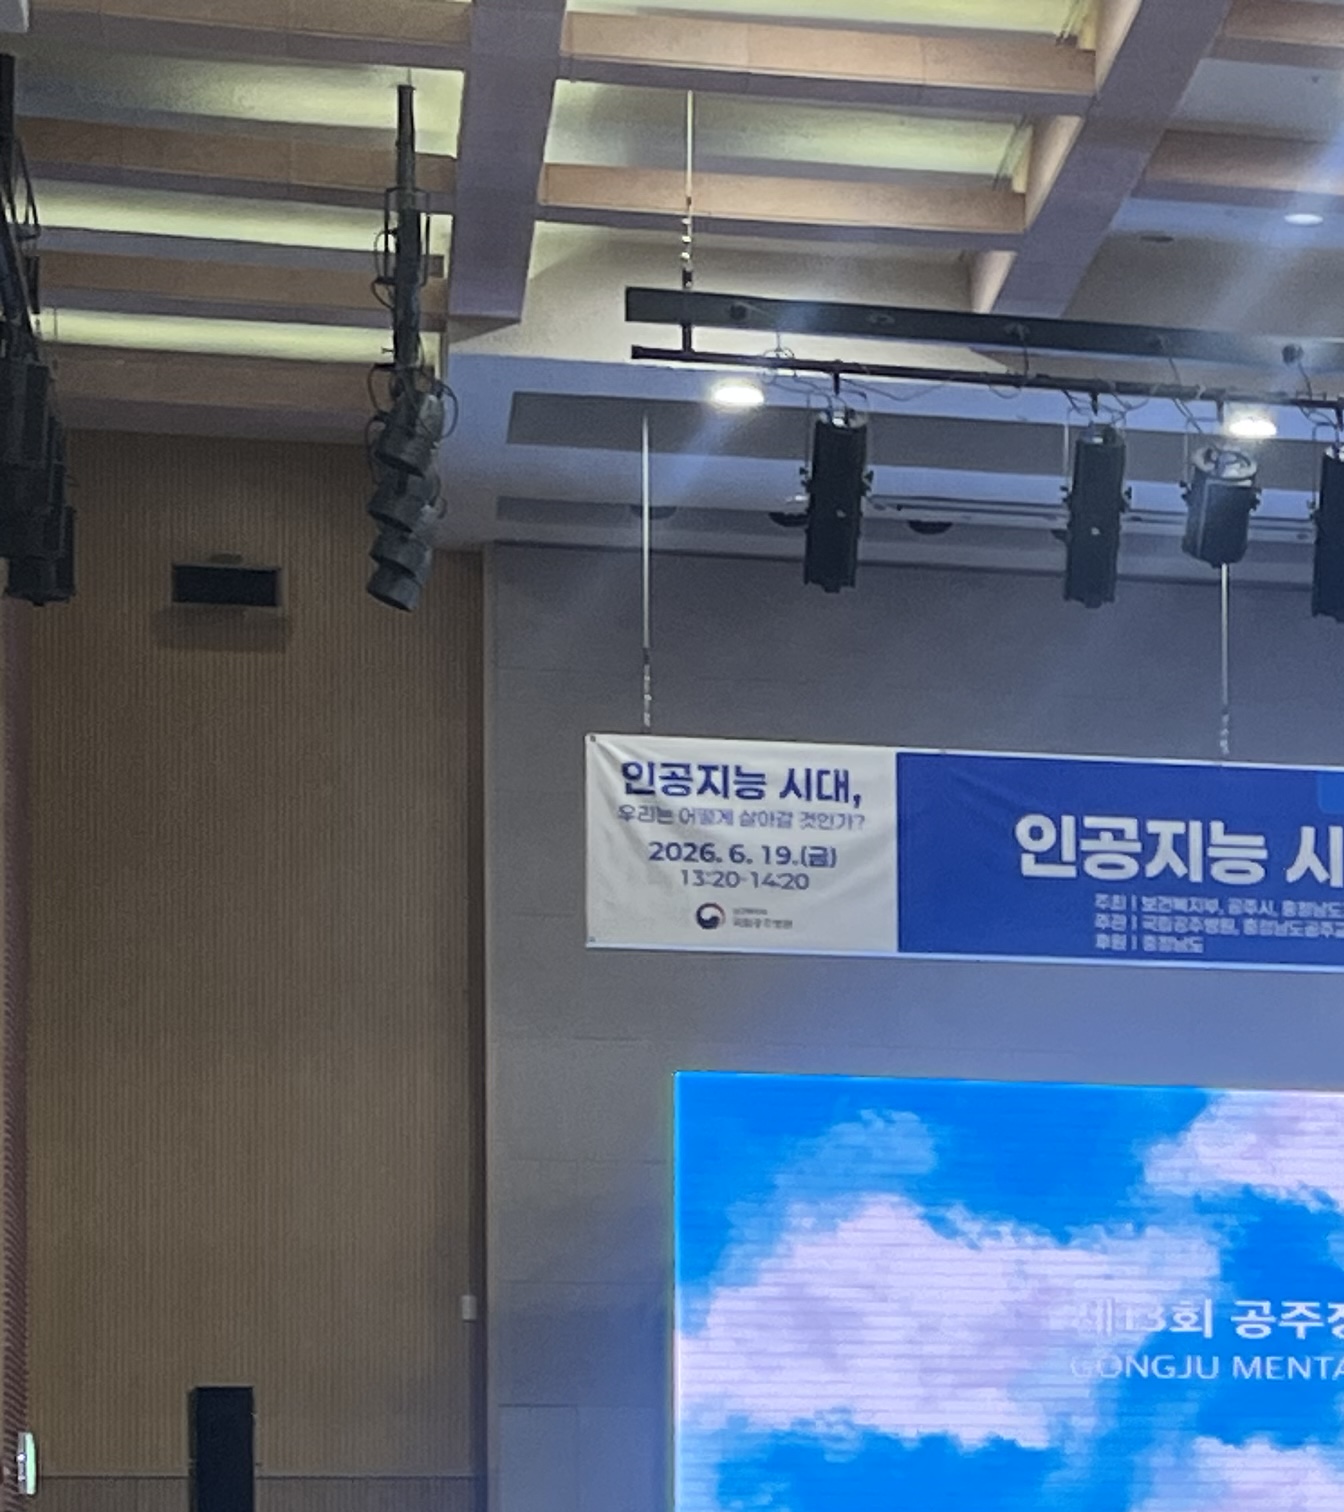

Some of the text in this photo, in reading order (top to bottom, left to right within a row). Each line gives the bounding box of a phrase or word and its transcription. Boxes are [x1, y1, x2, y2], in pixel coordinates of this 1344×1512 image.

[621, 761, 862, 808] 인공지능 시대,
[617, 804, 865, 831] 우리는 어떻게 살아갈 것인가?
[648, 841, 722, 863] 2026.
[729, 844, 753, 864] 6.
[1015, 814, 1268, 885] 인공지능
[1070, 1355, 1219, 1380] GONGJU
